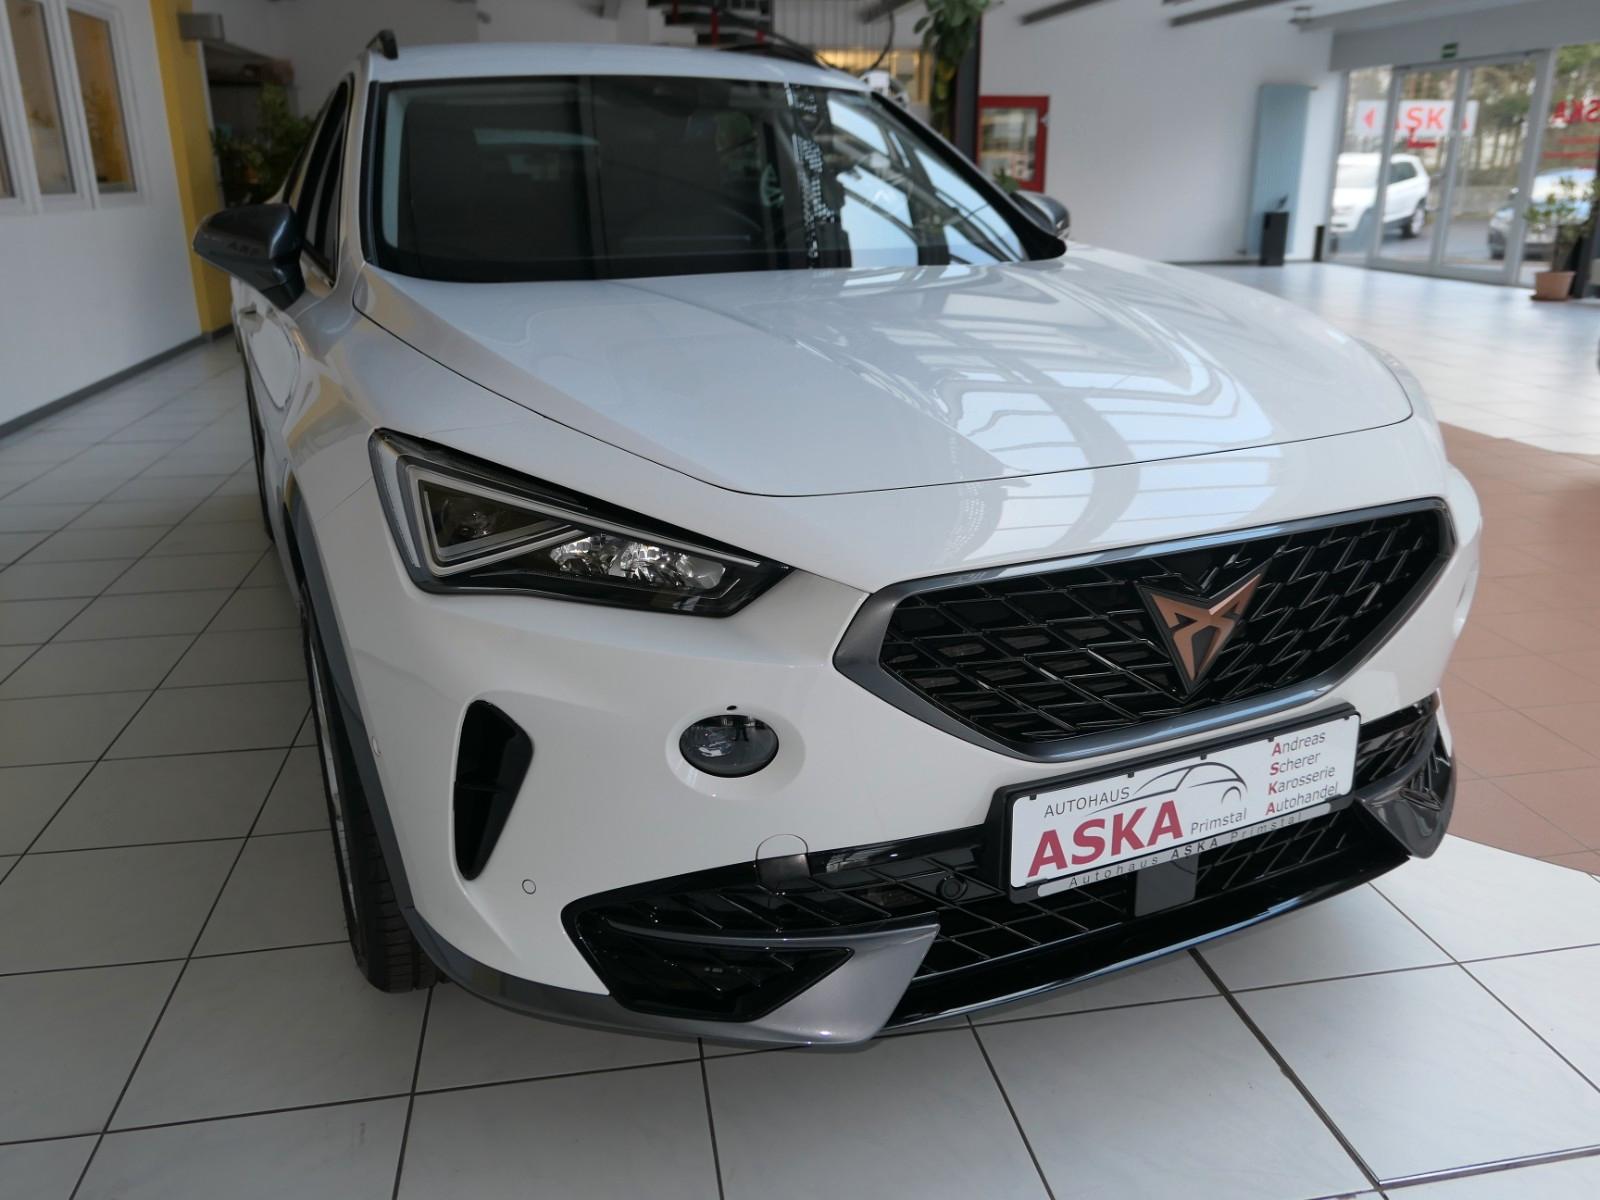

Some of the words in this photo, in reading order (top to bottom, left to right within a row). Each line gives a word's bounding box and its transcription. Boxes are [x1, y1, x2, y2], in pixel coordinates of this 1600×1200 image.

[1271, 731, 1326, 756] Andreas
[1269, 752, 1321, 776] Scherer
[1267, 765, 1336, 795] Karosserie
[1043, 787, 1131, 818] AUTOHAUS
[1264, 782, 1339, 816] Autohandel
[1190, 808, 1248, 836] Primstal
[1027, 800, 1184, 878] ASKA
[1068, 856, 1159, 889] Autohaus
[1170, 837, 1219, 860] ASKA
